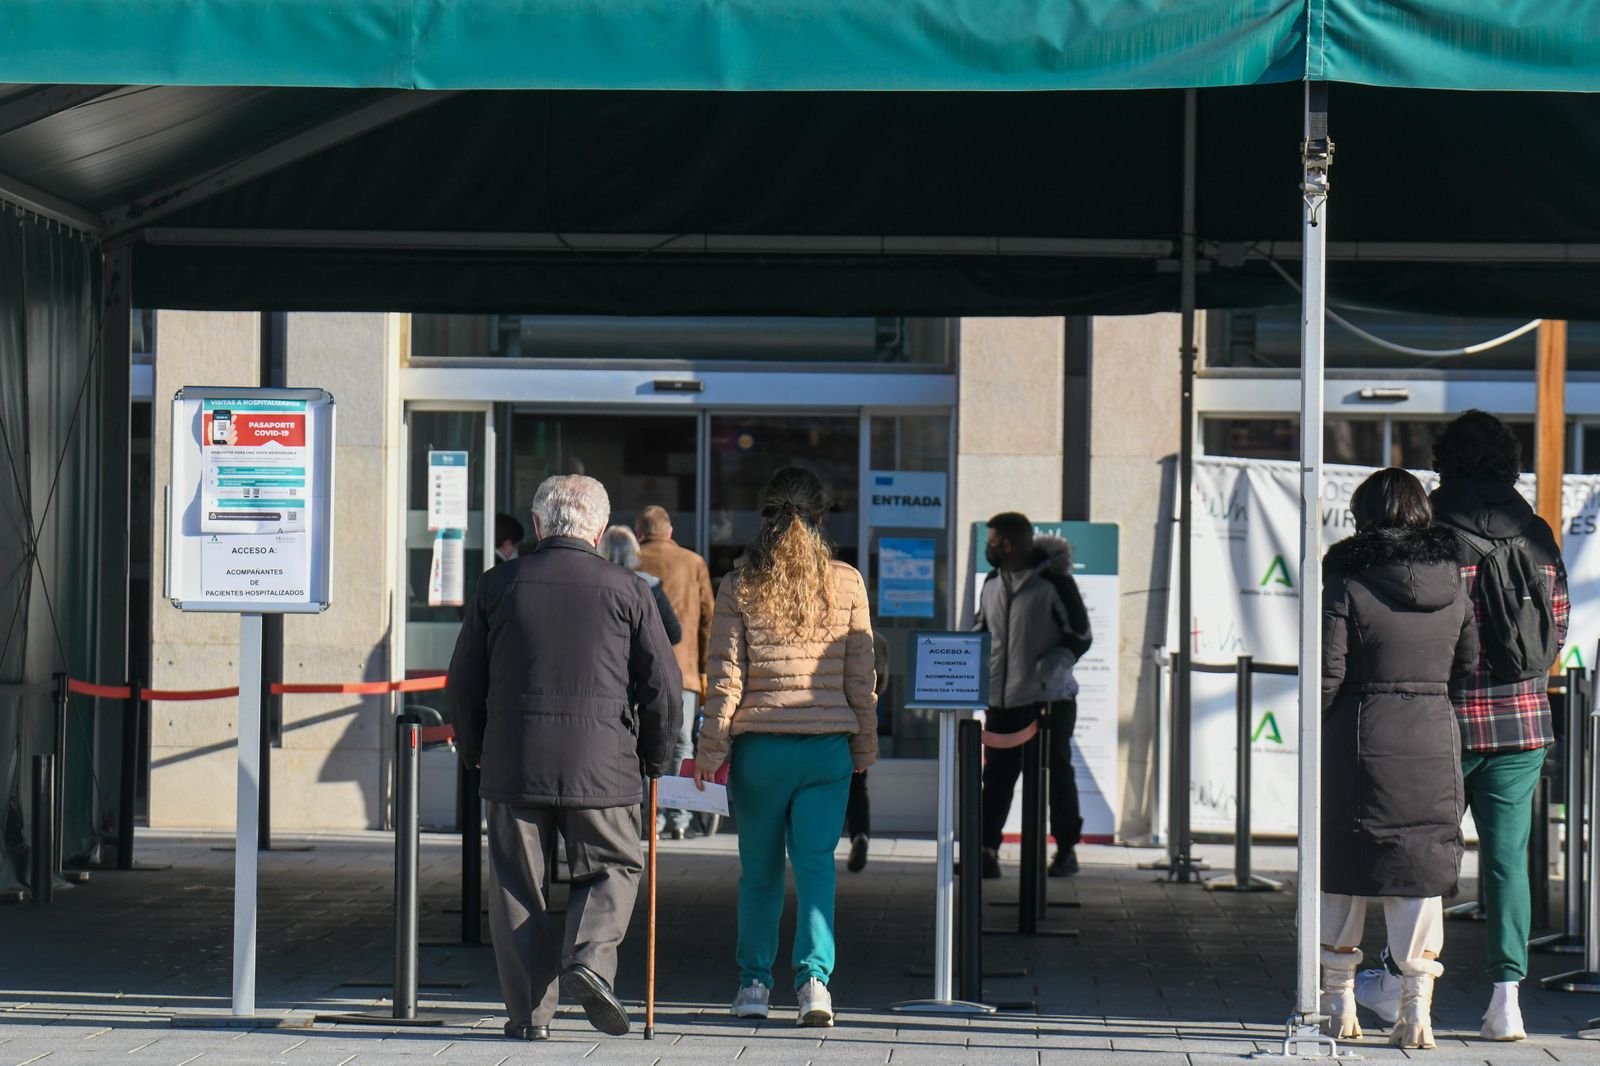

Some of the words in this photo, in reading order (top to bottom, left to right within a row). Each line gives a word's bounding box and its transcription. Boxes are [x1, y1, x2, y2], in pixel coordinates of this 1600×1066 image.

[872, 495, 942, 507] ENTRADA
[226, 567, 284, 576] ACOMPAÑANTES
[245, 589, 305, 597] HOSPITALIZADOS
